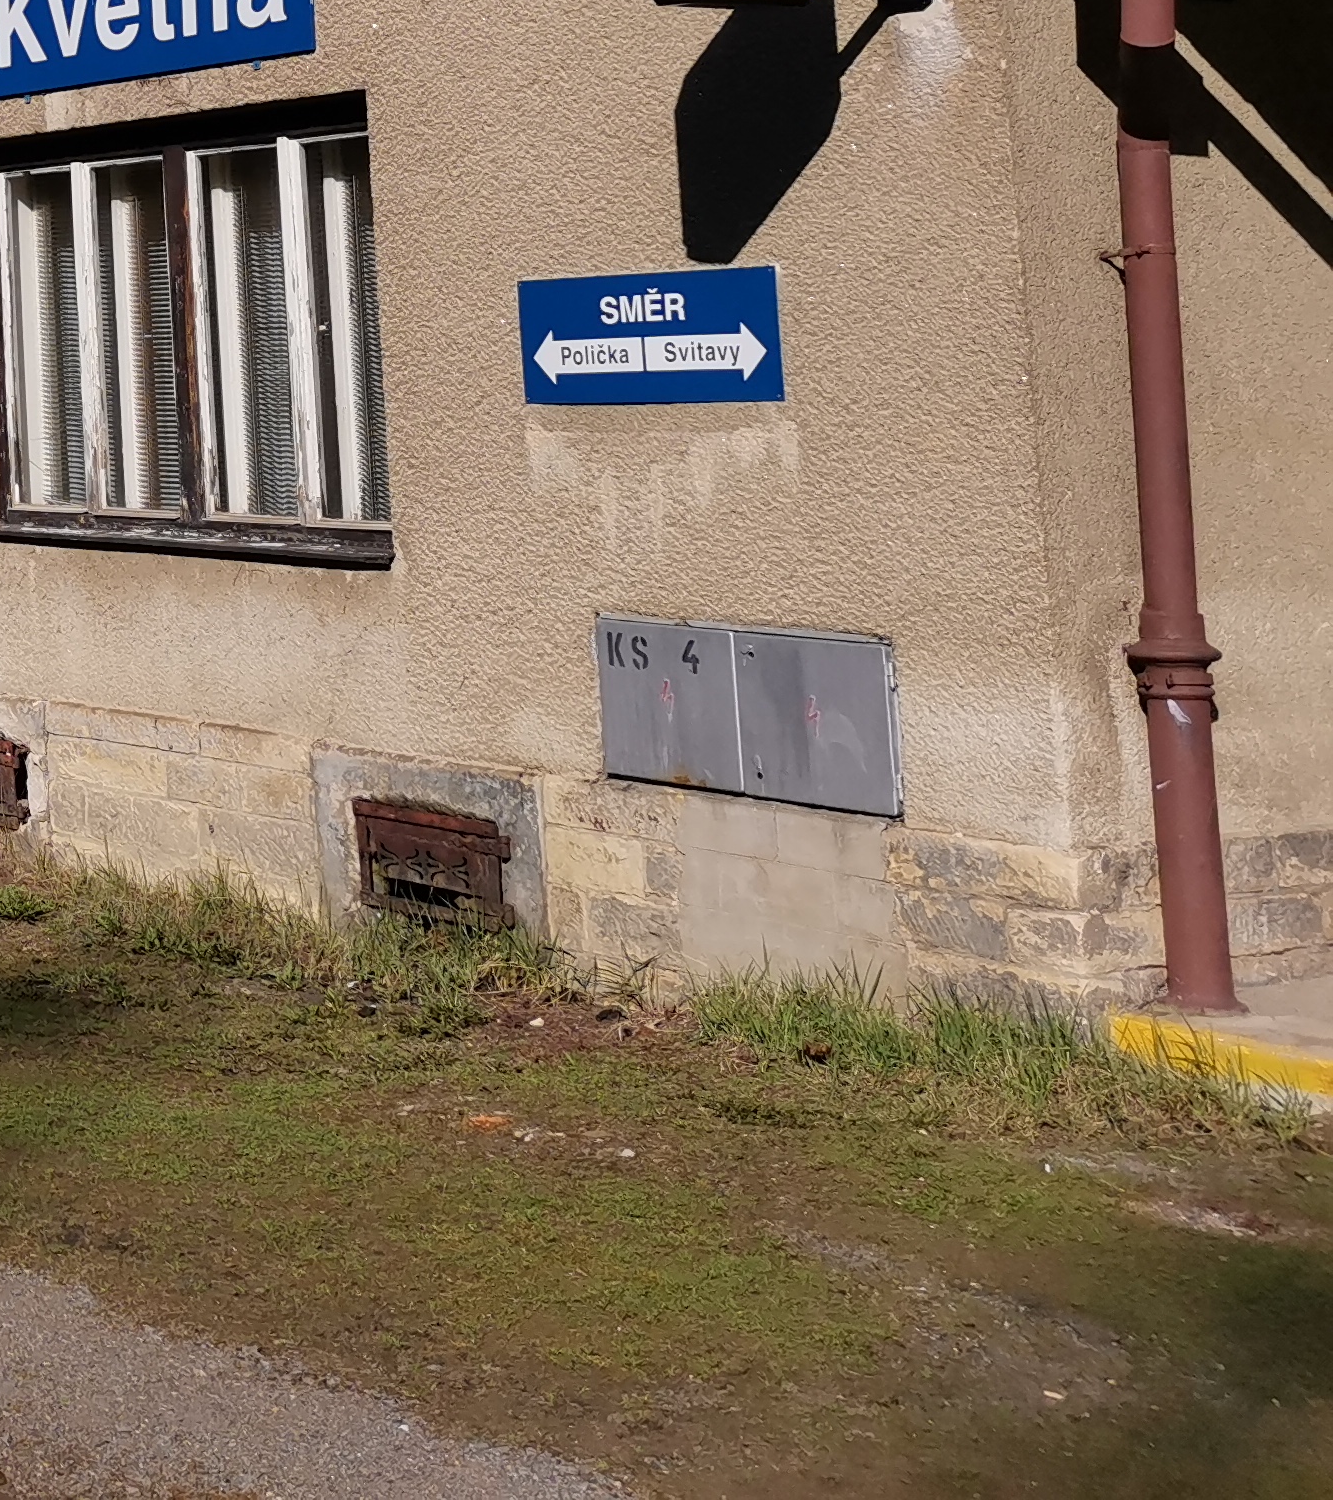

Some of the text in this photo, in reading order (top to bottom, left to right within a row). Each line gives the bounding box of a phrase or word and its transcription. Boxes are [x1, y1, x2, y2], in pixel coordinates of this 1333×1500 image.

[599, 287, 686, 325] SMĚR
[560, 343, 630, 366] Polička
[663, 340, 741, 367] Svitavy
[605, 631, 700, 674] KS 4
